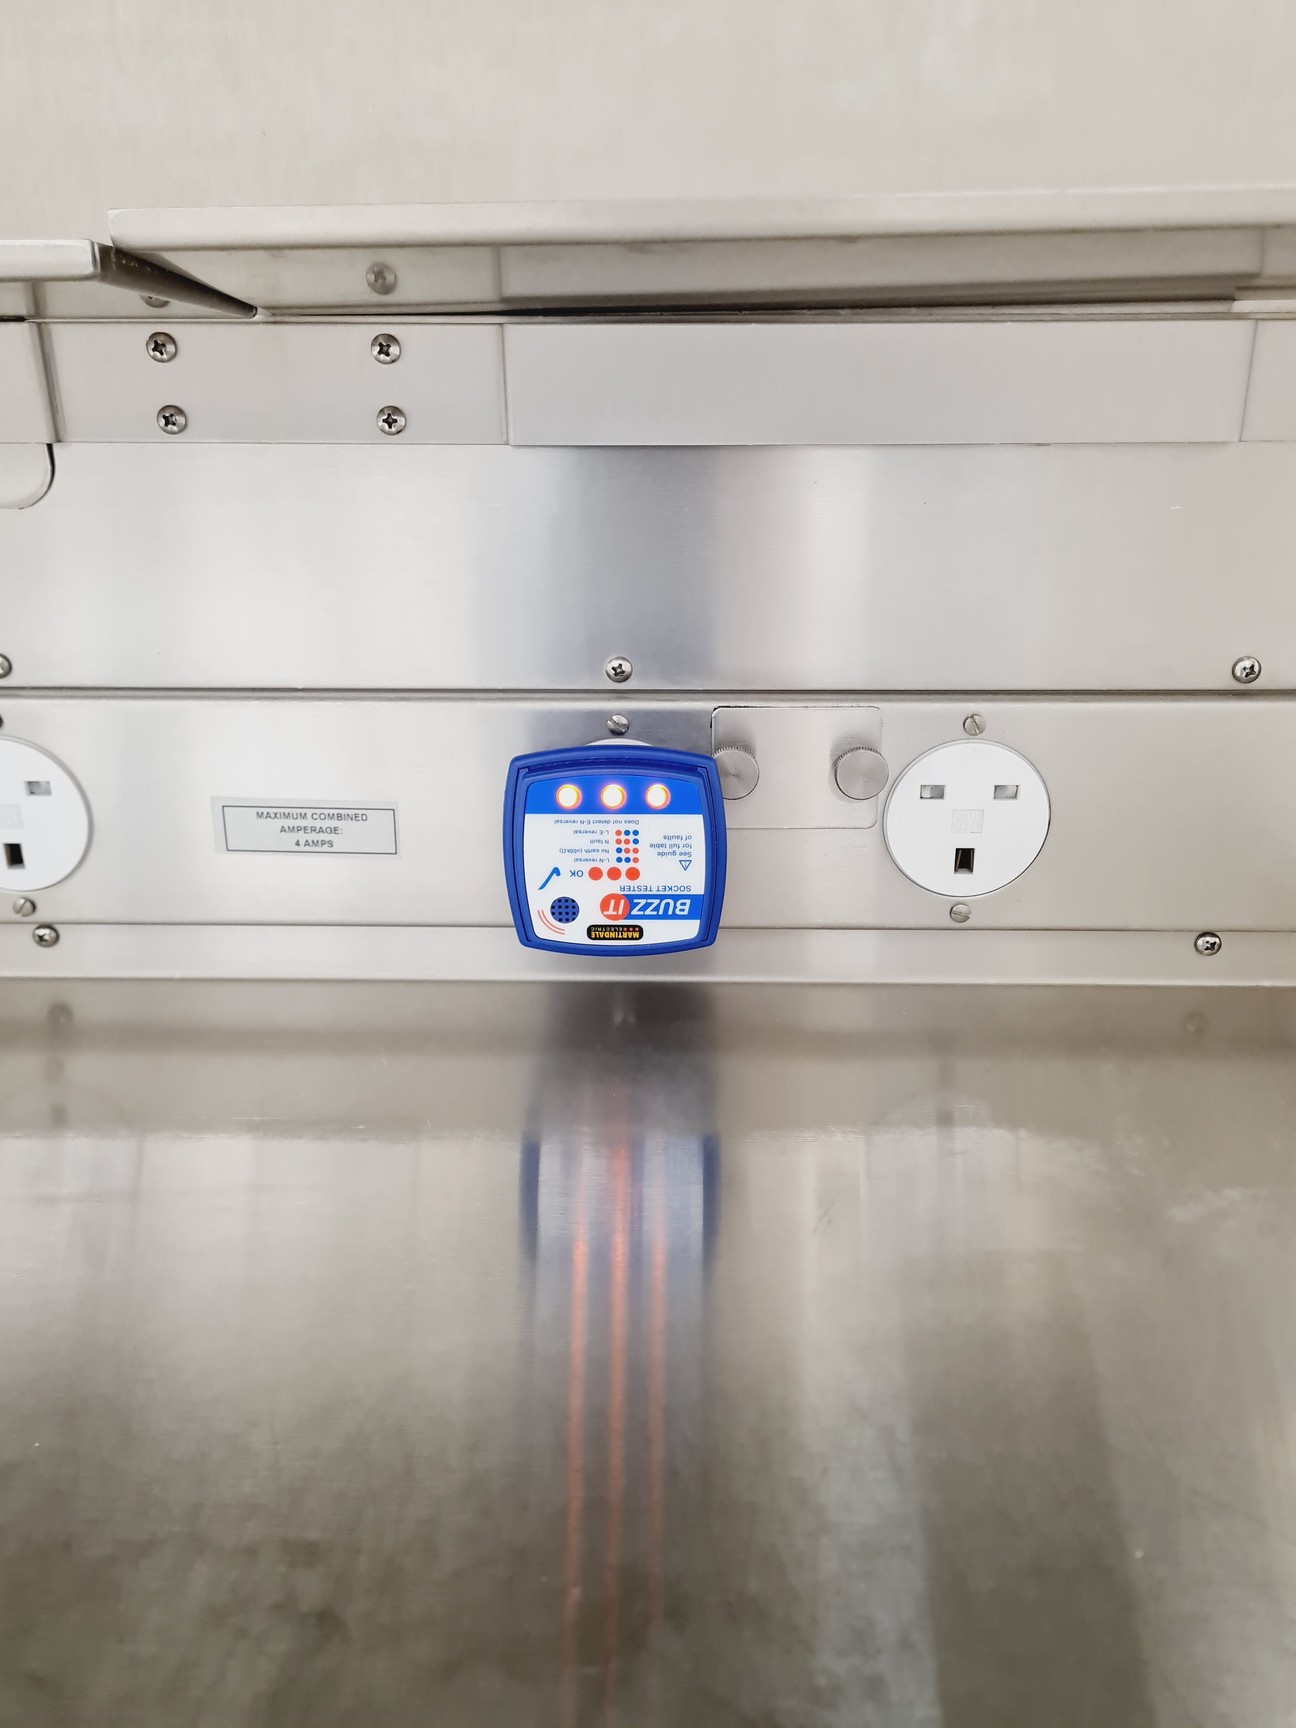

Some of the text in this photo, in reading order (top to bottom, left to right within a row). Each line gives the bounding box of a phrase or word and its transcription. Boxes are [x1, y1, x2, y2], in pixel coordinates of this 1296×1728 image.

[256, 812, 368, 821] MAXIMUM COMBINED
[280, 826, 343, 834] AMPERAGE:
[295, 840, 334, 848] 4 AMPS
[603, 899, 691, 915] BUZZ IT
